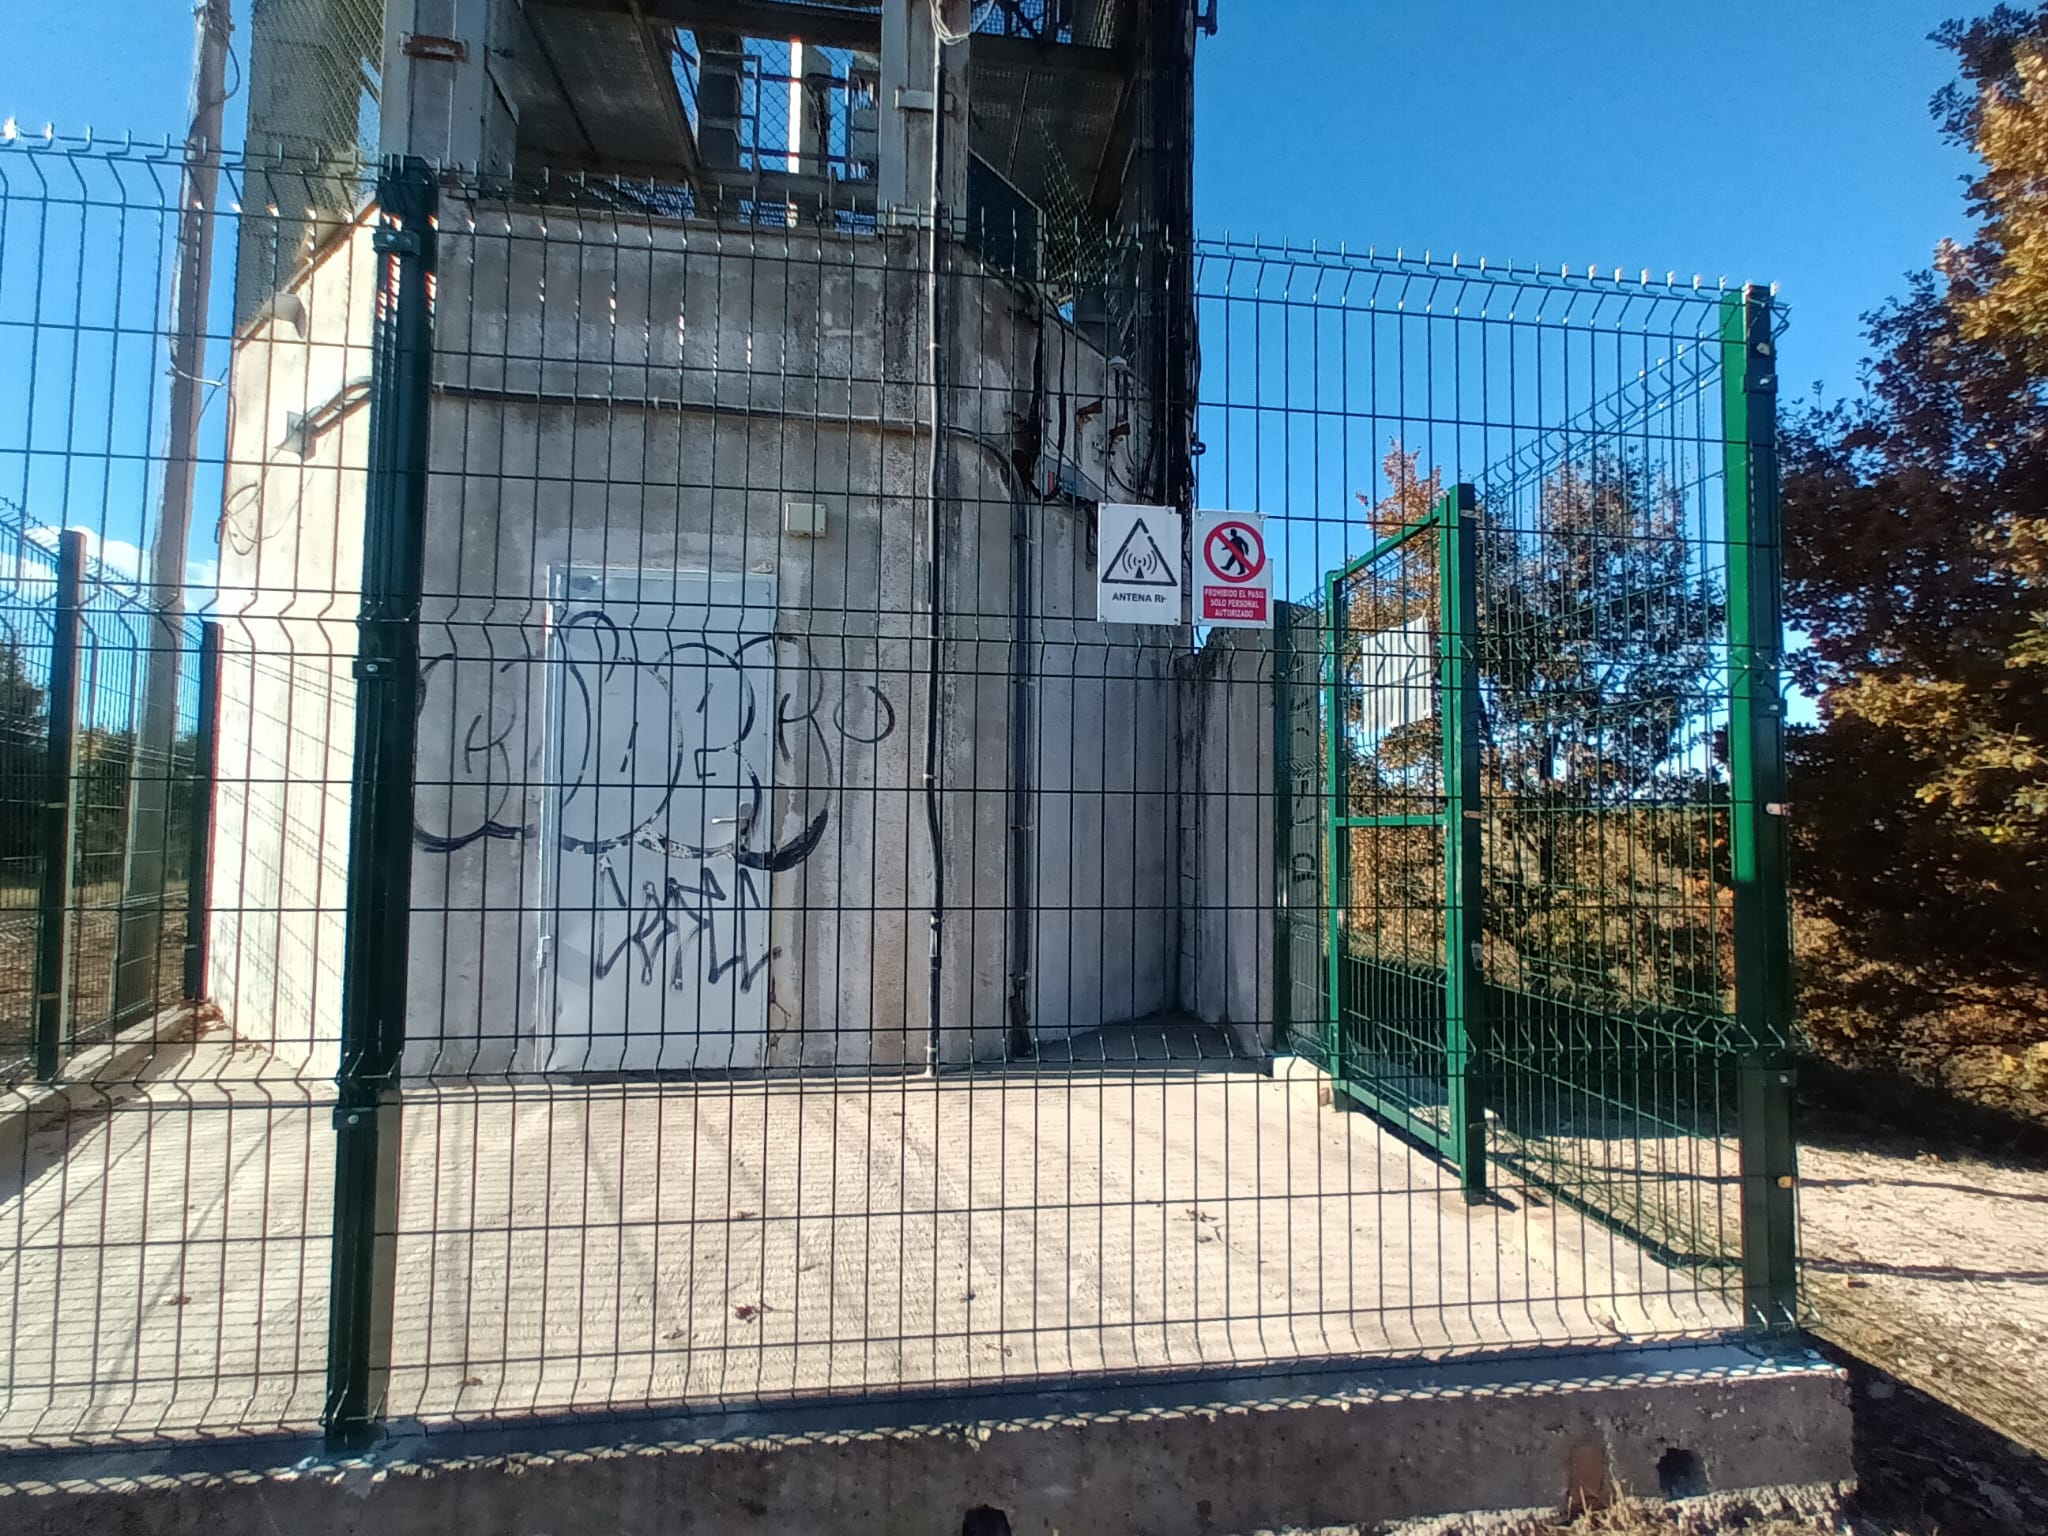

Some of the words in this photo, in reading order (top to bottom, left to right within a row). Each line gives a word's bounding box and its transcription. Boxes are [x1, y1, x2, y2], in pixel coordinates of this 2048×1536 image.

[1112, 592, 1152, 603] ANTENA
[1204, 588, 1238, 598] PROHIBIDO
[1239, 590, 1247, 599] EL
[1228, 599, 1259, 608] PERSONAL
[1215, 608, 1253, 618] AUTORIZADO
